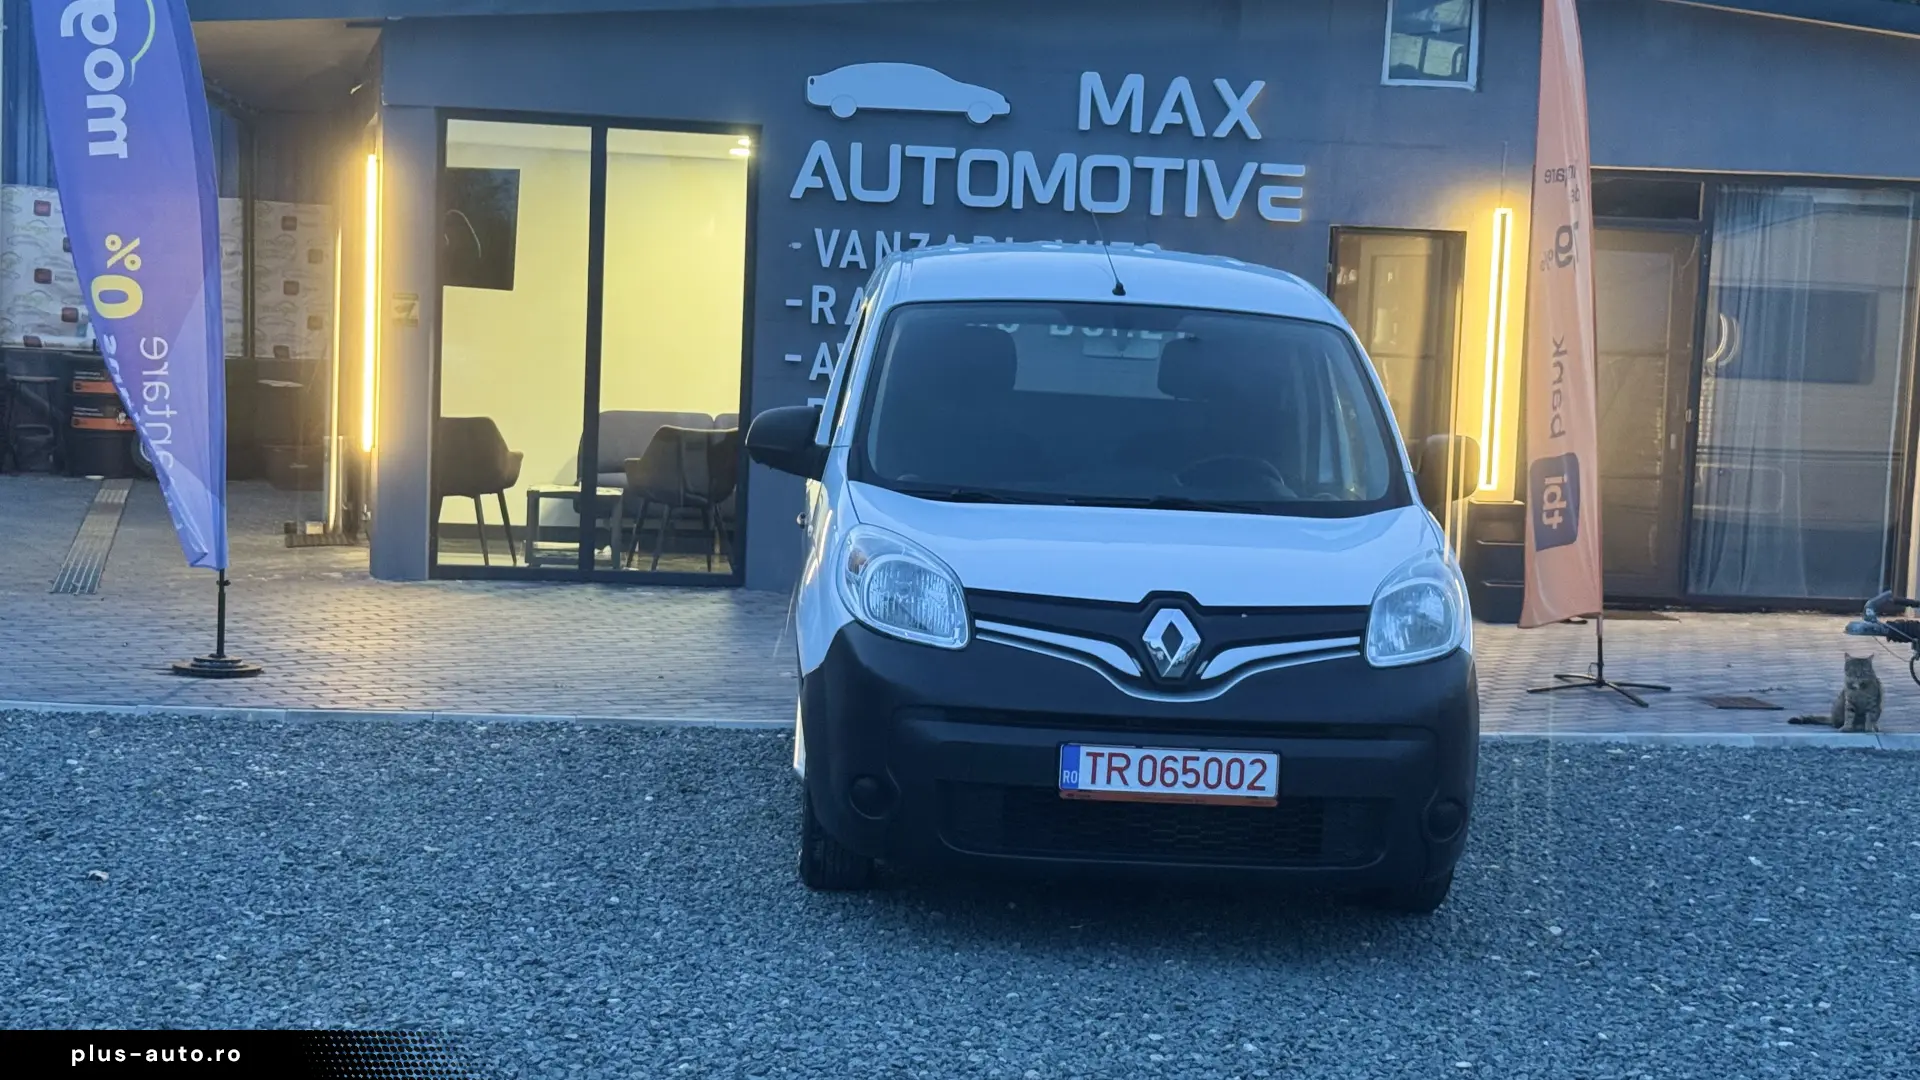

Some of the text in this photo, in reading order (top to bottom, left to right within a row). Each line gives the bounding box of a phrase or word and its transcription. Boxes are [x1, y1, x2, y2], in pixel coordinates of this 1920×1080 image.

[1078, 71, 1266, 140] MAX
[789, 140, 1306, 223] AUTOMOTIVE
[1062, 770, 1078, 785] RO
